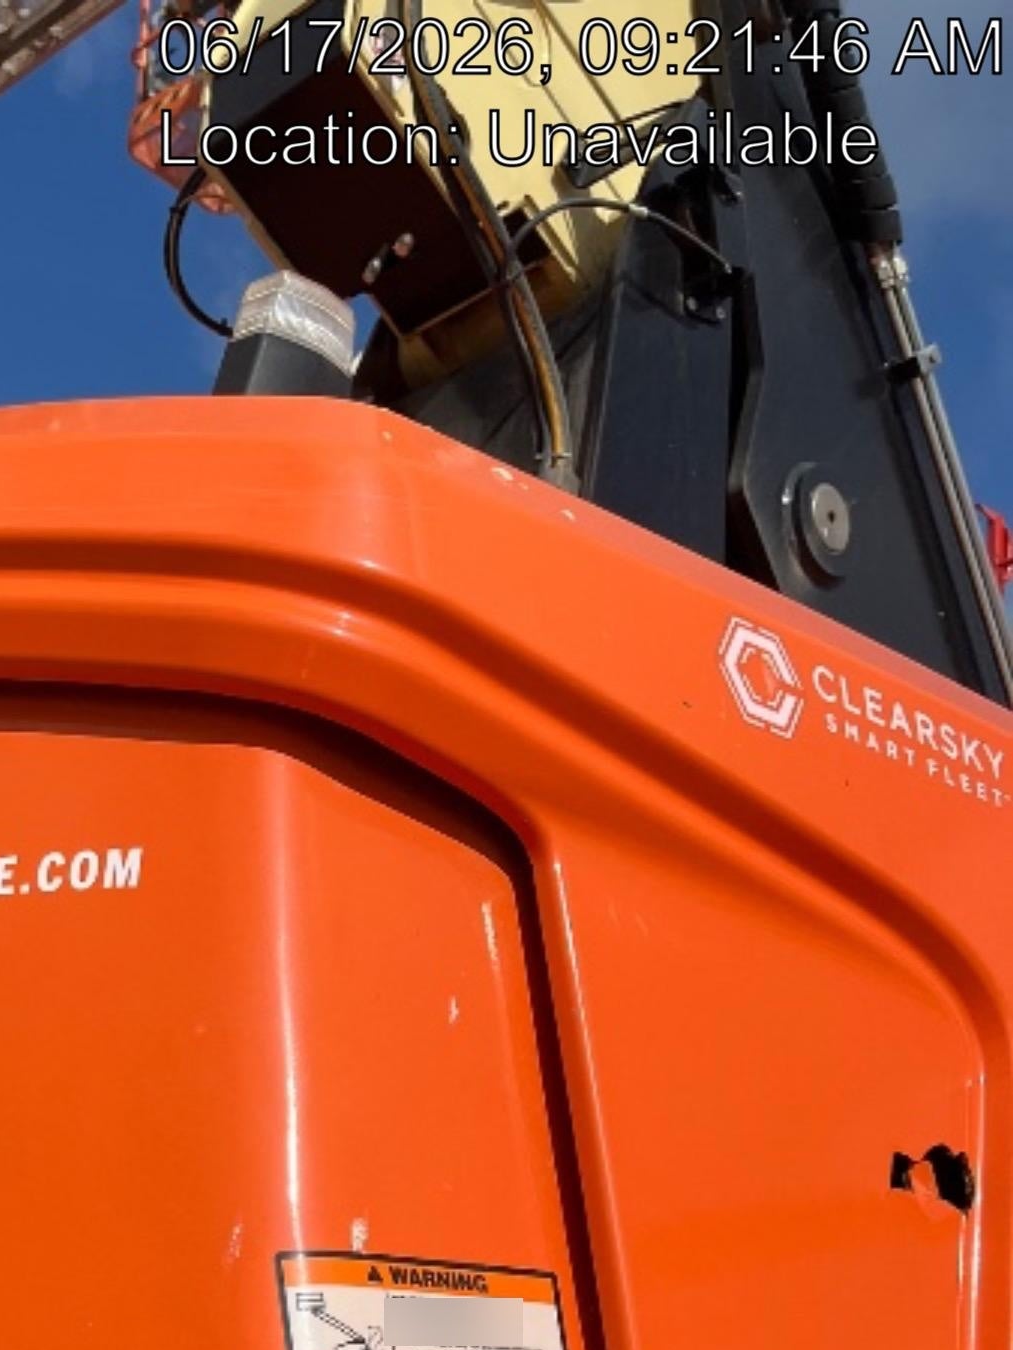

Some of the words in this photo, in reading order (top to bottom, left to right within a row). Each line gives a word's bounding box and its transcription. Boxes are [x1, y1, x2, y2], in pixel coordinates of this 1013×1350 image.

[811, 664, 1005, 780] CLEARSKY
[824, 712, 916, 767] SMART
[388, 1265, 489, 1293] WARNING
